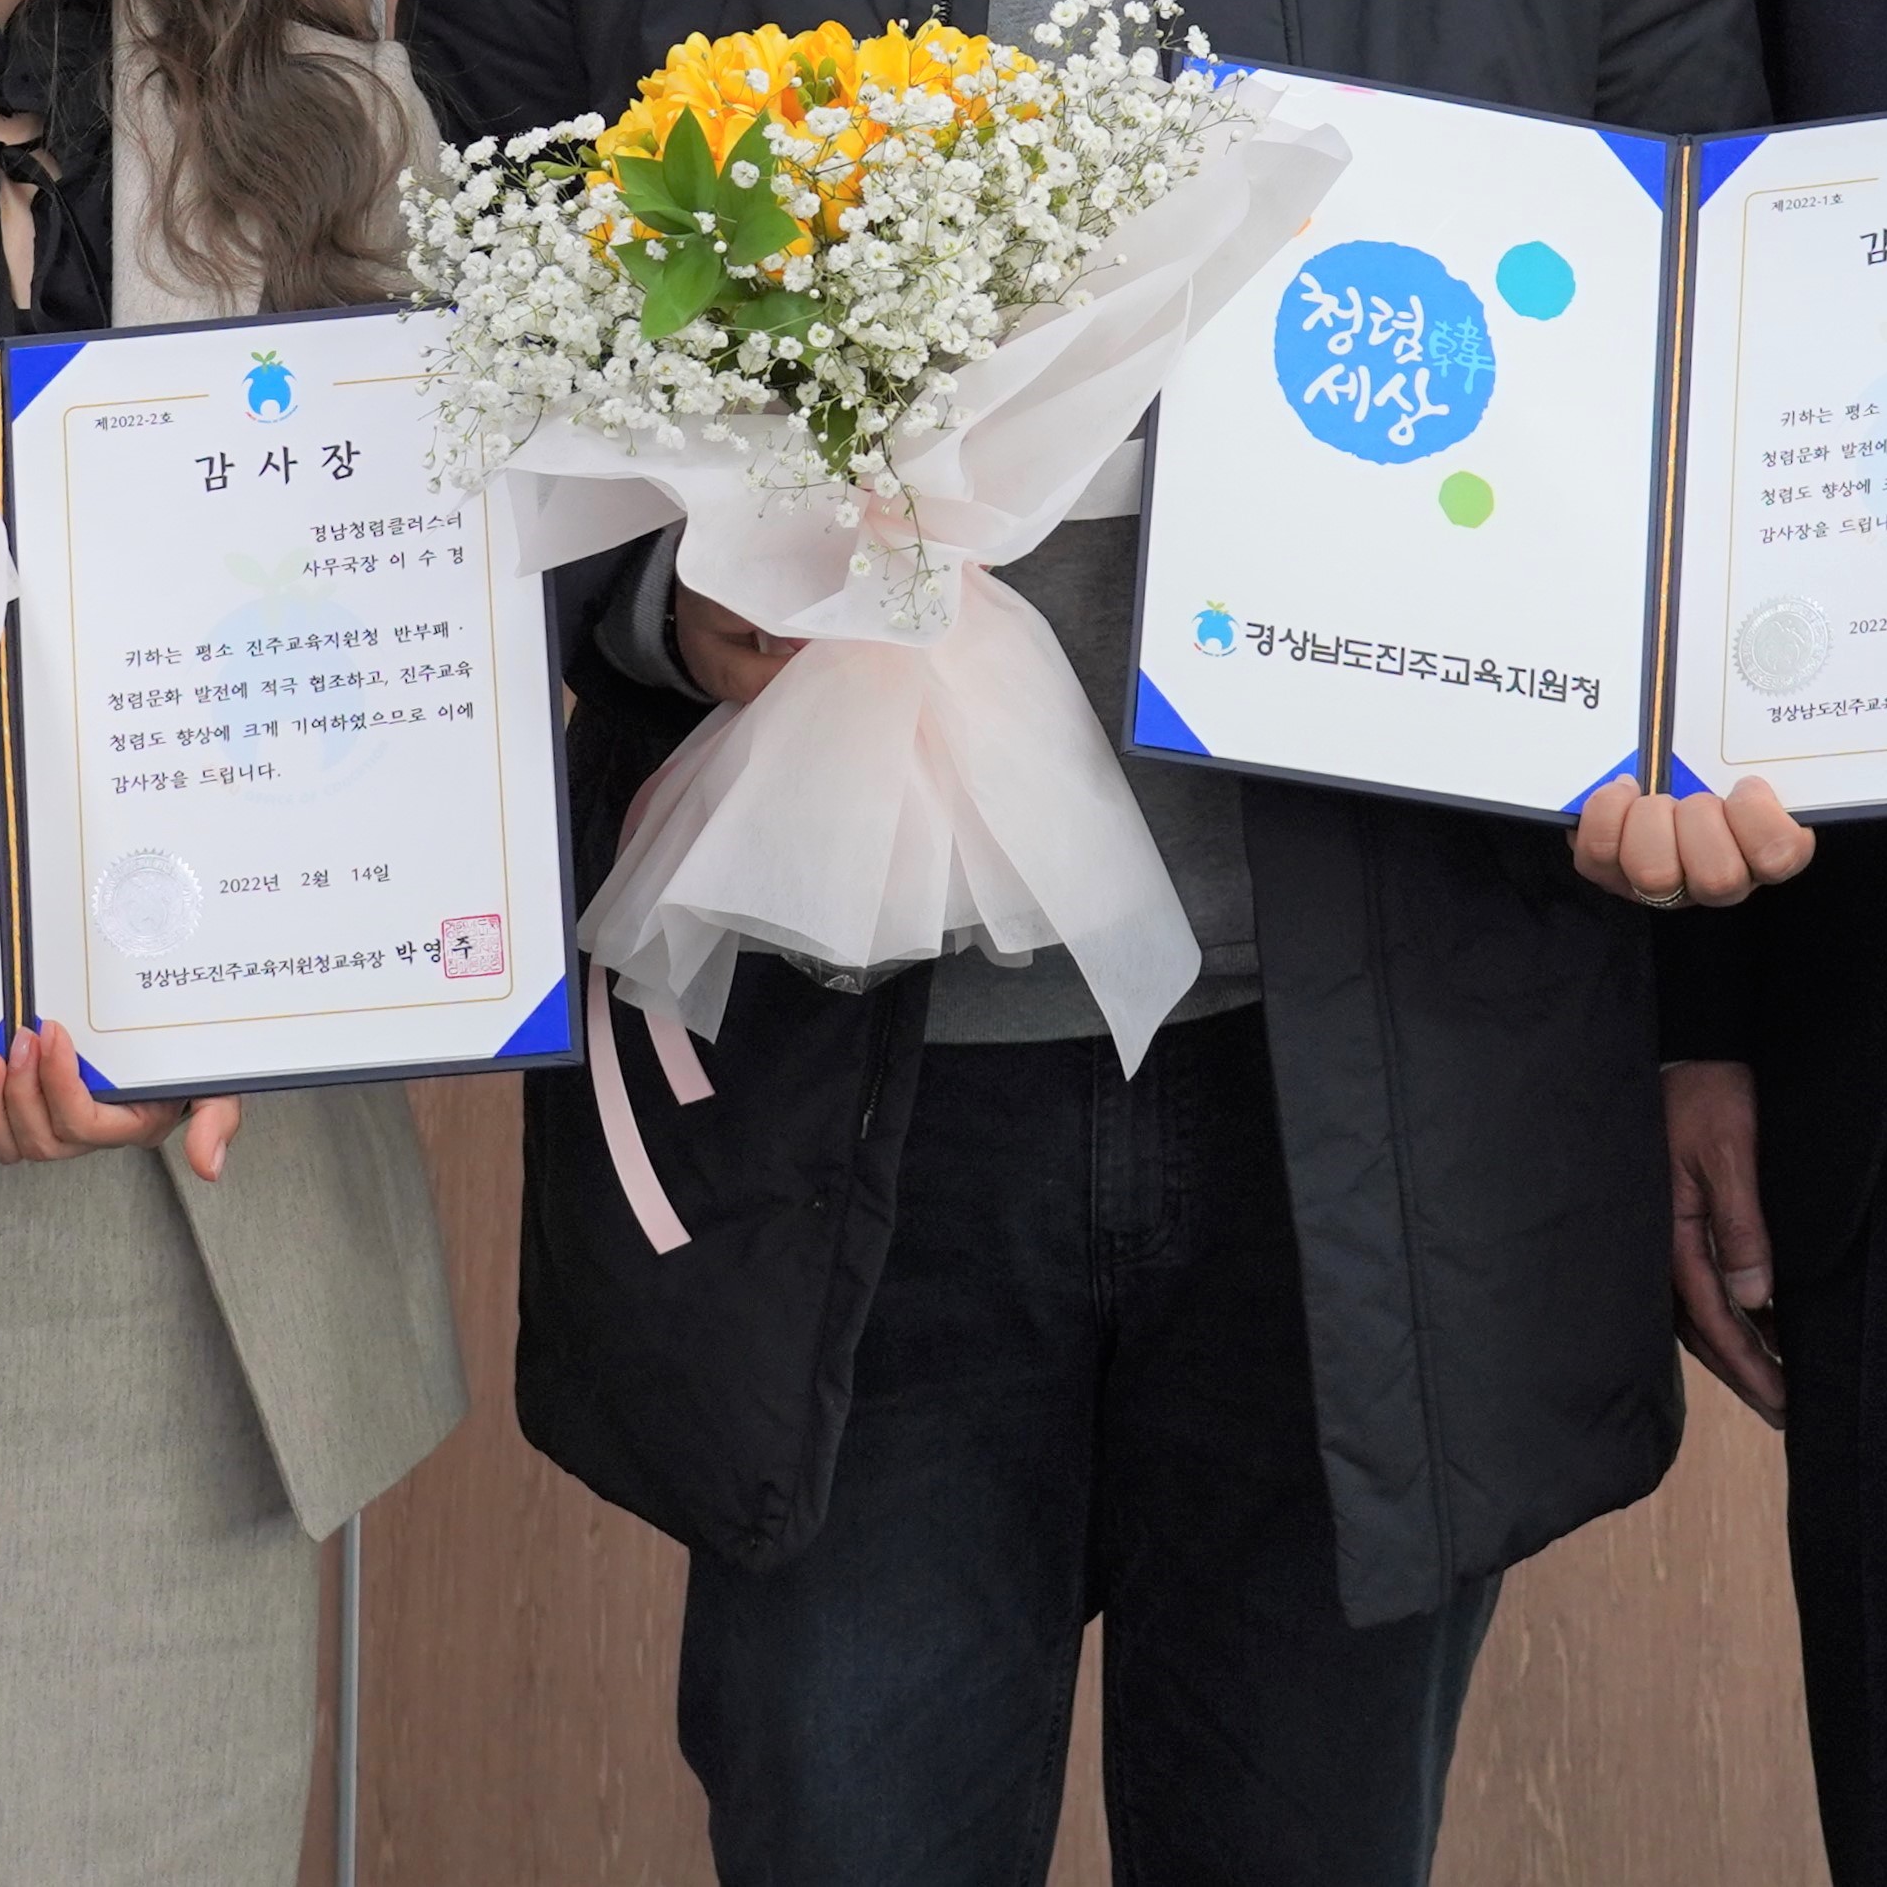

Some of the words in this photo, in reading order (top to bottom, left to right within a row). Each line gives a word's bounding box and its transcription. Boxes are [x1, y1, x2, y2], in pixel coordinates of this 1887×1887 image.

[1772, 194, 1843, 212] 제2022-1호
[1298, 272, 1425, 363] 청렴
[1304, 363, 1450, 445] 세상
[1845, 403, 1879, 420] 평소
[95, 412, 174, 431] 제2022-2호
[1762, 445, 1830, 467] 청렴문화
[1761, 486, 1811, 506] 청렴도
[1822, 478, 1870, 499] 향상에
[309, 510, 463, 545] 경남청렴클러스터
[1760, 521, 1829, 544] 감사장을
[303, 555, 378, 577] 사무국장
[196, 644, 233, 661] 평소
[247, 628, 378, 657] 진주교육지원청
[1246, 622, 1599, 709] 경상남도진주교육지원청
[109, 688, 182, 711] 청렴문화
[195, 682, 247, 703] 발전에
[262, 678, 298, 696] 적극
[310, 671, 388, 693] 협조하고,
[401, 661, 473, 684] 진주교육
[110, 732, 166, 752] 청렴도
[177, 725, 230, 746] 향상에
[244, 720, 278, 737] 크게
[292, 708, 426, 734] 기여하였으므로
[438, 702, 473, 721] 이에
[112, 770, 188, 794] 감사장을
[200, 763, 280, 785] 드립니다.
[220, 874, 280, 893] 2022년
[302, 869, 330, 888] 2월
[352, 864, 390, 882] 14일
[136, 950, 385, 989] 경상남도진주교육지원청교육장
